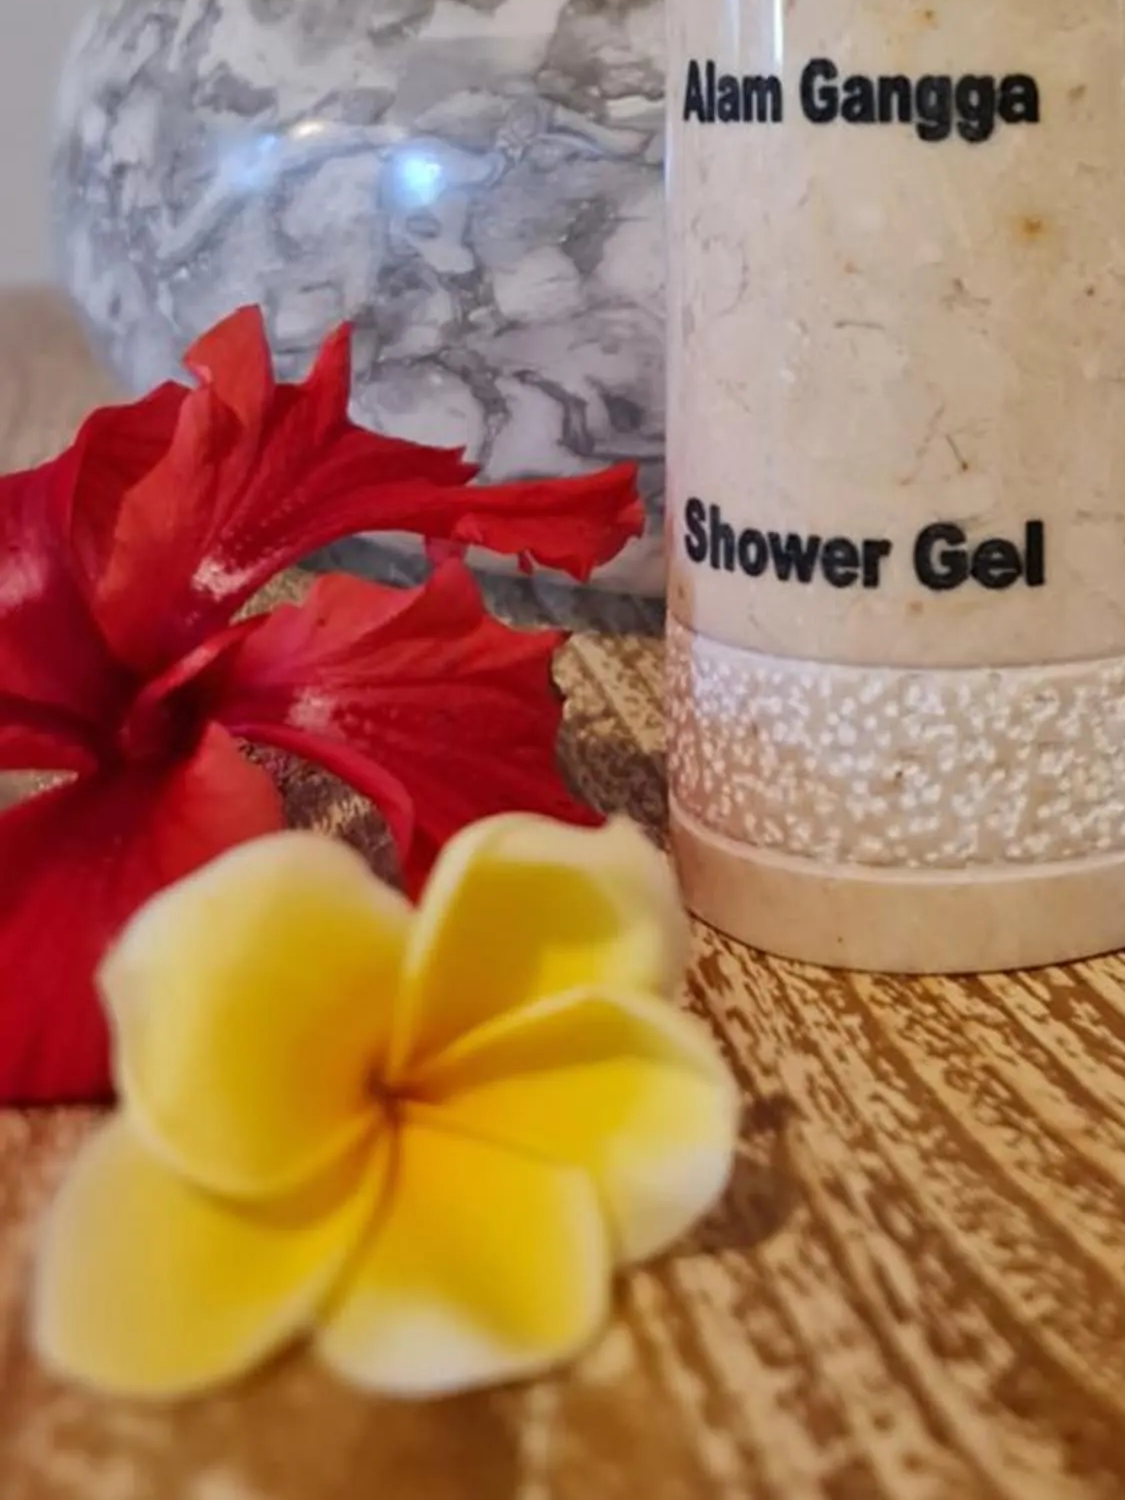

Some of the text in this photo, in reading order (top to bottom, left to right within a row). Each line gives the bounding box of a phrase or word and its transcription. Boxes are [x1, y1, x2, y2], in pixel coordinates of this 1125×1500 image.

[683, 57, 1041, 145] Alam Gangga
[683, 497, 1047, 593] Shower Gel
